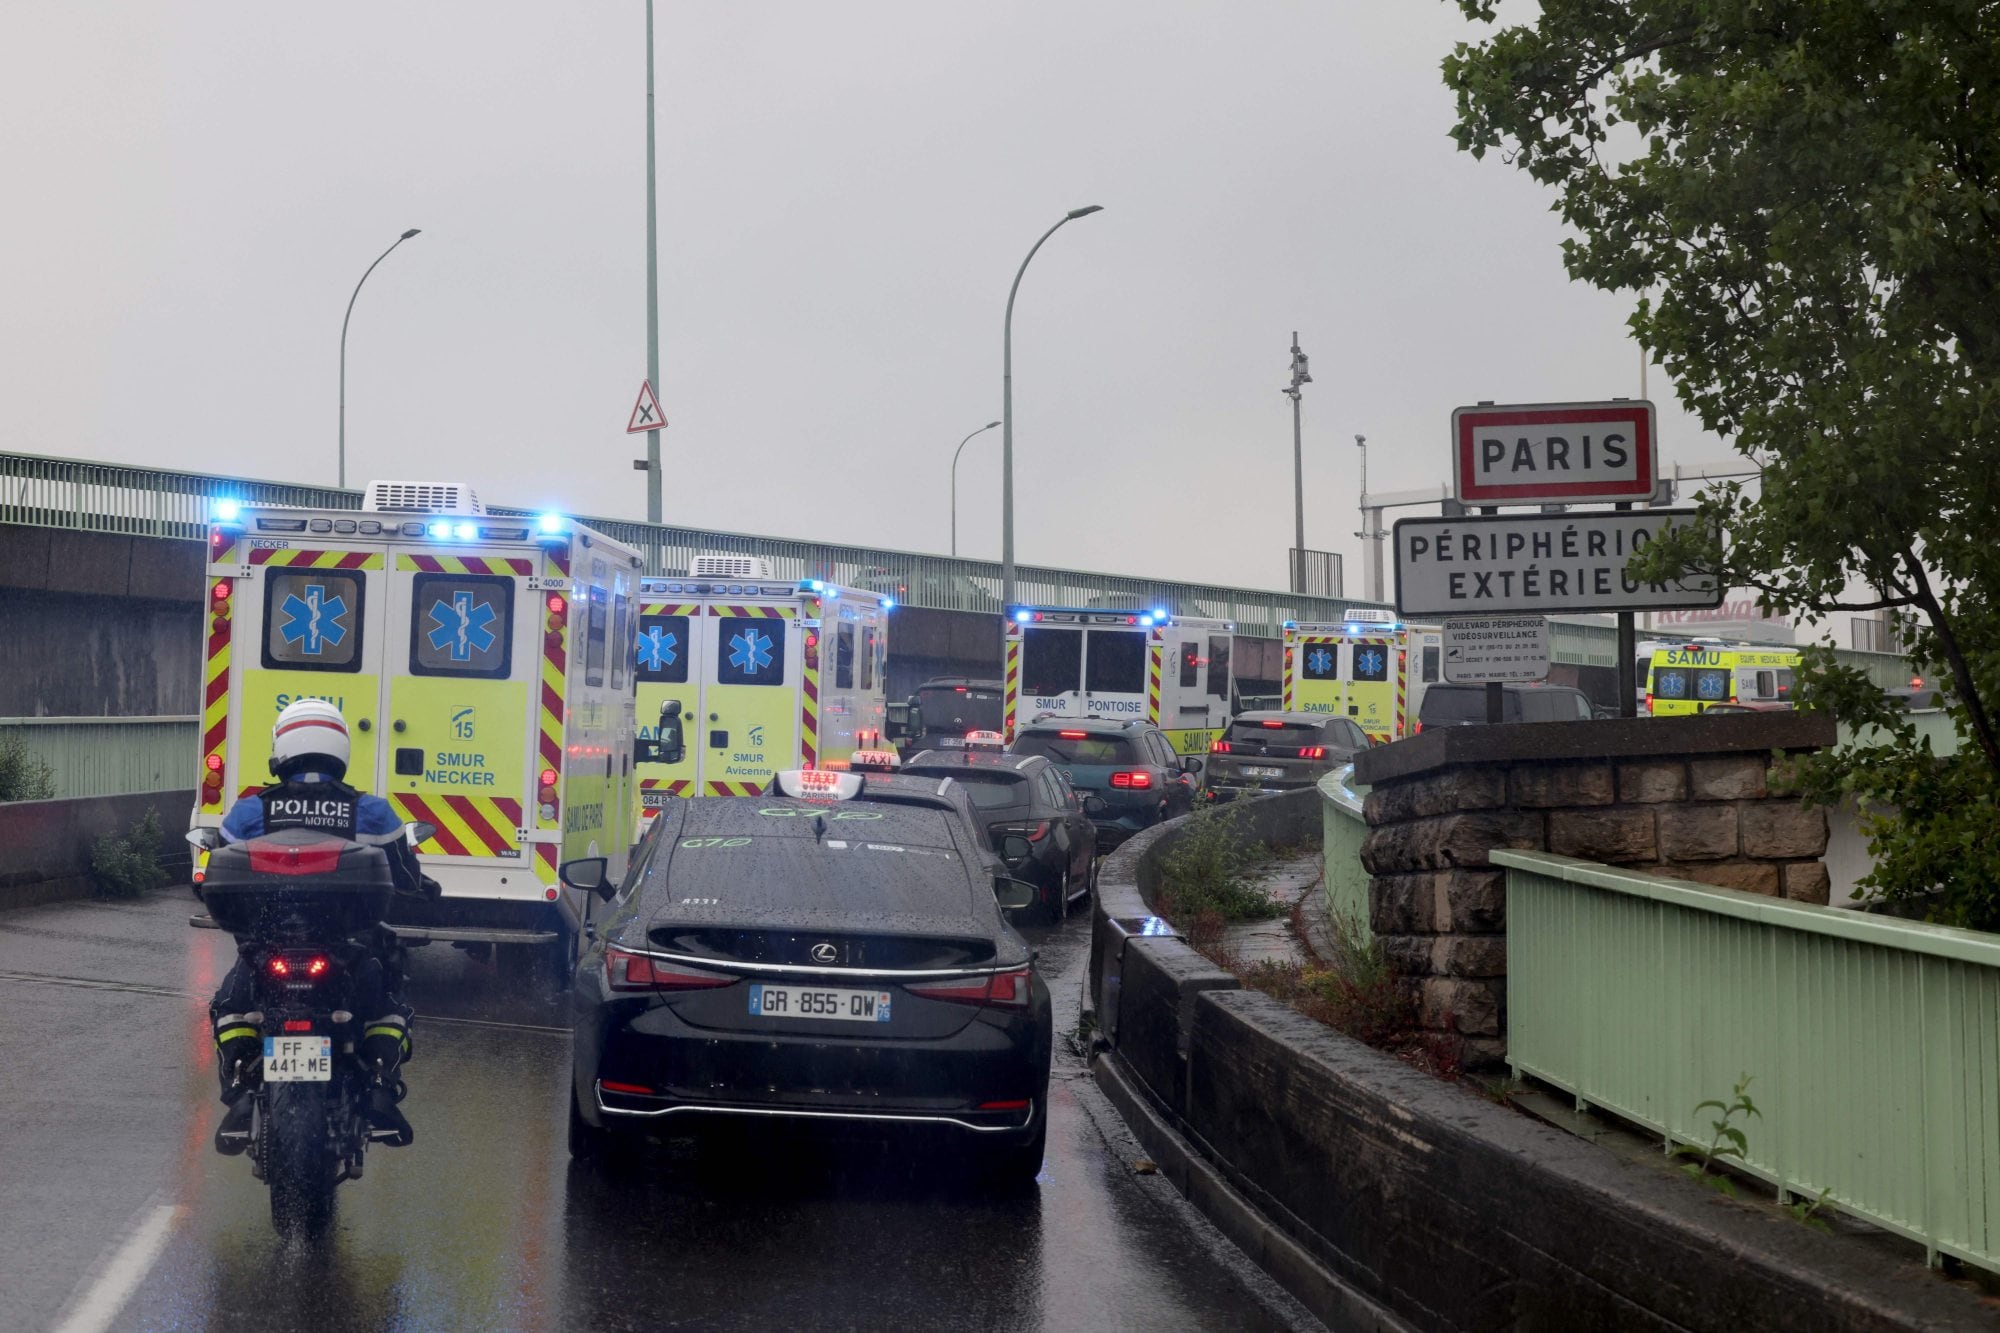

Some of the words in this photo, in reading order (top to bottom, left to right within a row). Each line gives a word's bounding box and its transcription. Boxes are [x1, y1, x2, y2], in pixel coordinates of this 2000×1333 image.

[1481, 433, 1628, 473] PARIS
[251, 540, 289, 549] NECKER
[1446, 621, 1490, 630] BOULEVARD
[1452, 631, 1537, 640] VIDÉOSURVEILLANCE
[1667, 649, 1721, 665] SAMU
[1035, 698, 1066, 710] SMUR
[1087, 700, 1141, 712] PONTOISE
[1303, 703, 1334, 713] SAMU
[455, 721, 473, 738] 15
[751, 734, 763, 746] 15
[1184, 732, 1204, 752] SAMU
[436, 752, 485, 768] SMUR
[733, 753, 764, 763] SMUR
[862, 754, 892, 765] TAXI
[725, 765, 773, 776] Avicenne
[425, 769, 495, 786] NECKER
[801, 791, 839, 800] PARISIEN
[270, 799, 350, 817] POLICE
[305, 816, 335, 827] MOTO
[337, 818, 349, 828] 93
[566, 806, 581, 834] SAMU
[590, 802, 603, 829] PARIS
[879, 1008, 890, 1018] 75
